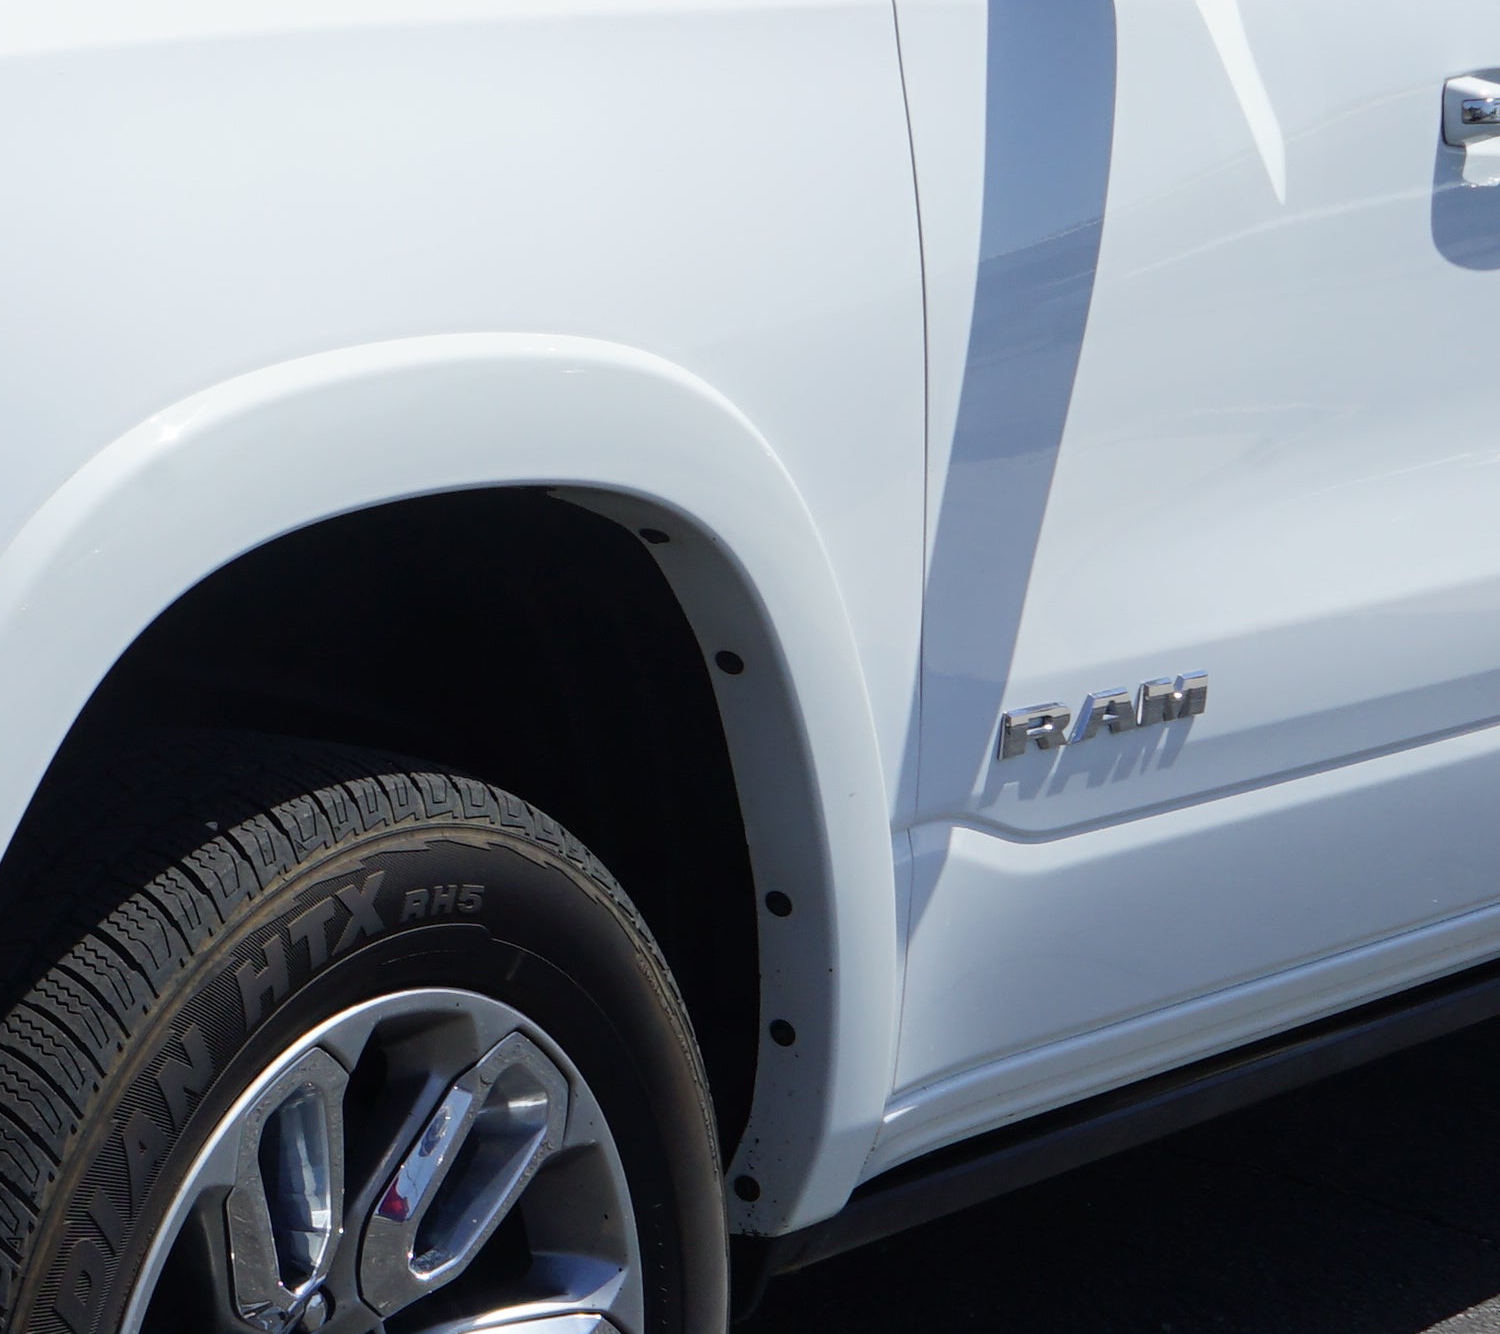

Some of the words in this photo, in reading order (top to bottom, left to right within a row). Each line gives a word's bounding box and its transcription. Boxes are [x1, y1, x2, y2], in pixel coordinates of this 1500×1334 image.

[996, 669, 1209, 762] RAM
[234, 869, 388, 1033] HTX
[398, 883, 486, 924] RH5
